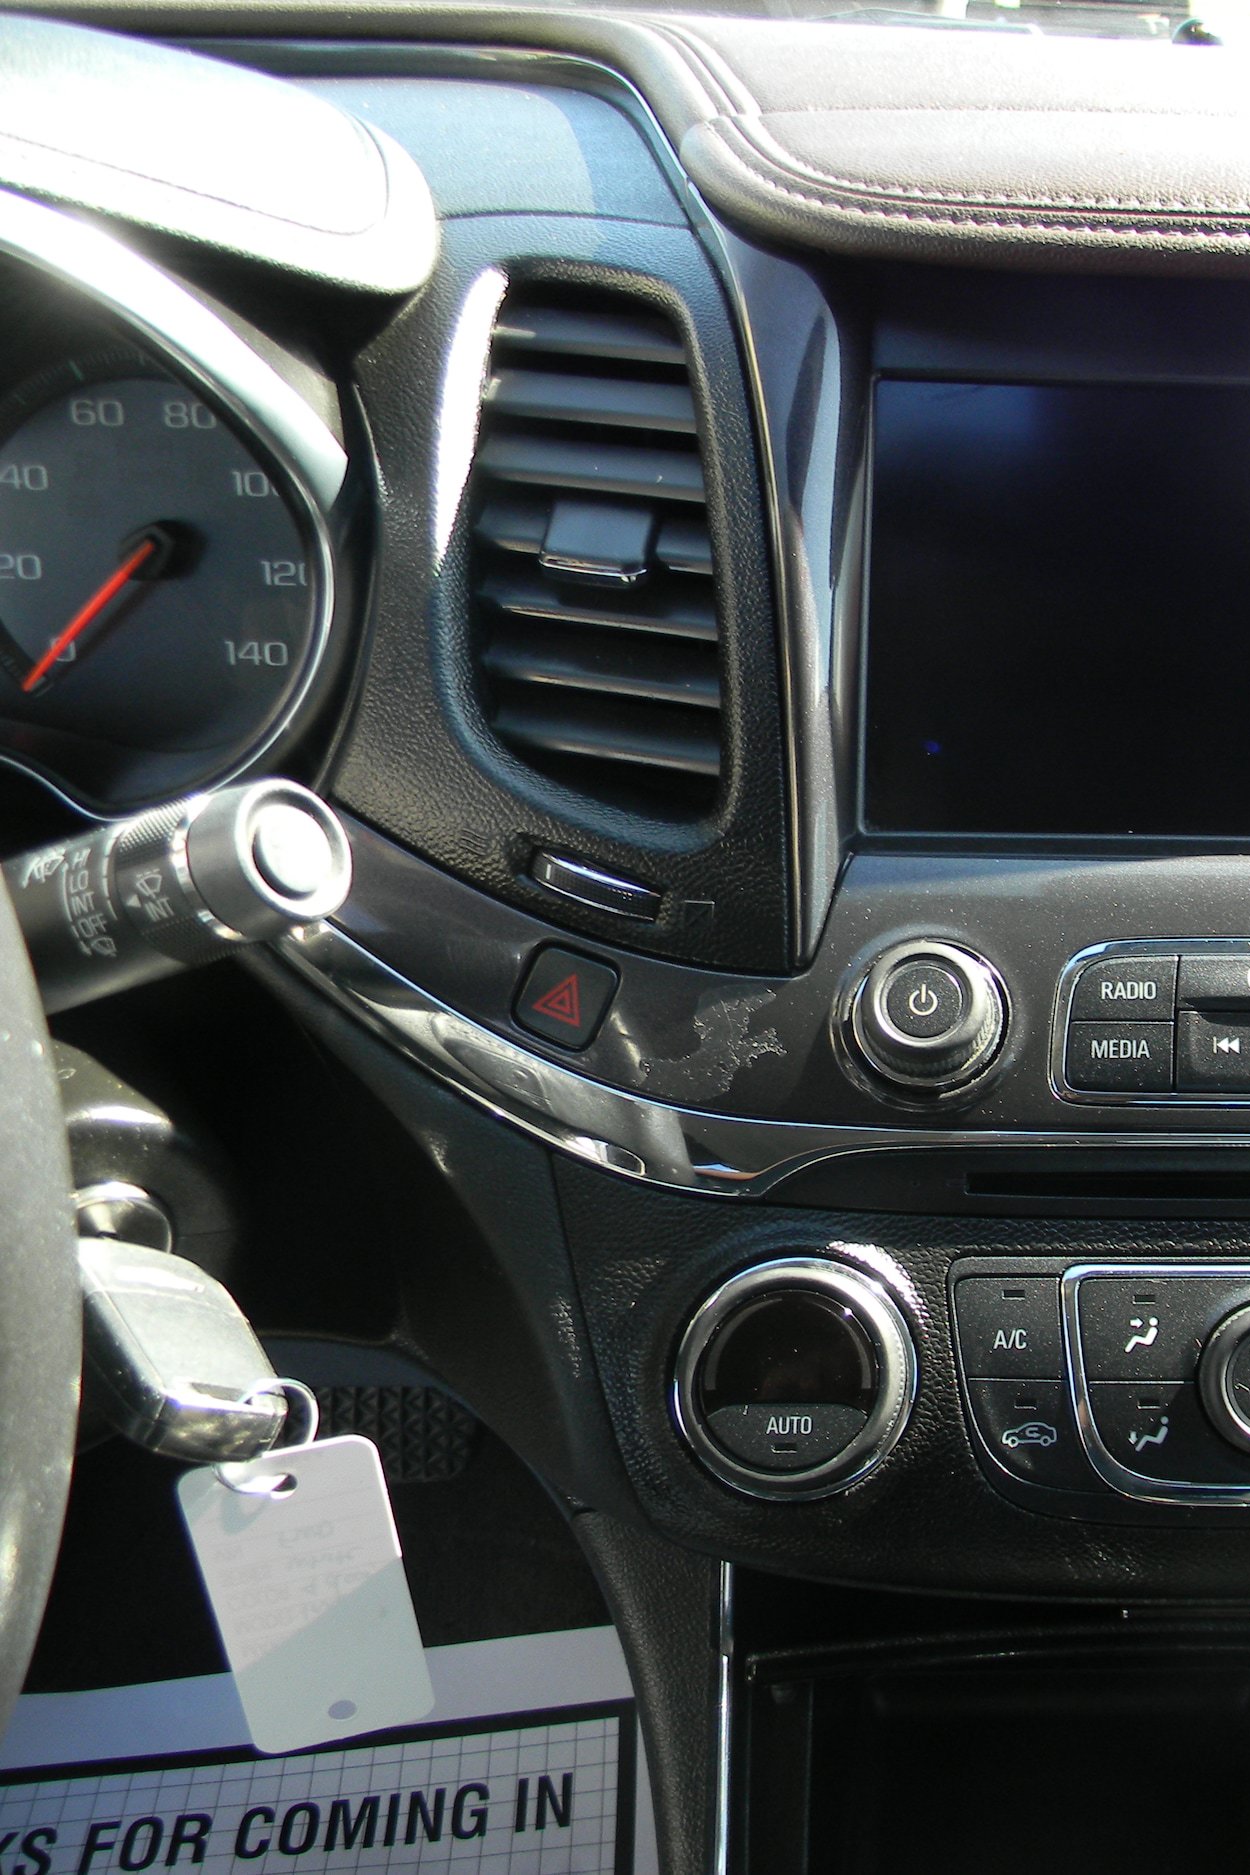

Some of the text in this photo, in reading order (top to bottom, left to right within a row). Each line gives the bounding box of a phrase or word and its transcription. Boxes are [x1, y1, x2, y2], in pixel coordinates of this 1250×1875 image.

[70, 400, 125, 427] 60
[0, 464, 48, 491] 40
[231, 471, 280, 497] 10
[225, 640, 289, 666] 140
[71, 848, 92, 870] HI
[69, 869, 89, 893] LO
[71, 891, 95, 916] INT
[144, 896, 175, 922] INT
[77, 913, 108, 938] OFF
[1101, 980, 1156, 1000] RADIO
[1091, 1039, 1151, 1060] MEDIA
[993, 1329, 1027, 1351] A/C
[766, 1415, 813, 1435] AUTO
[77, 1812, 214, 1875] FOR
[234, 1782, 490, 1859] COMING
[514, 1772, 574, 1834] IN
